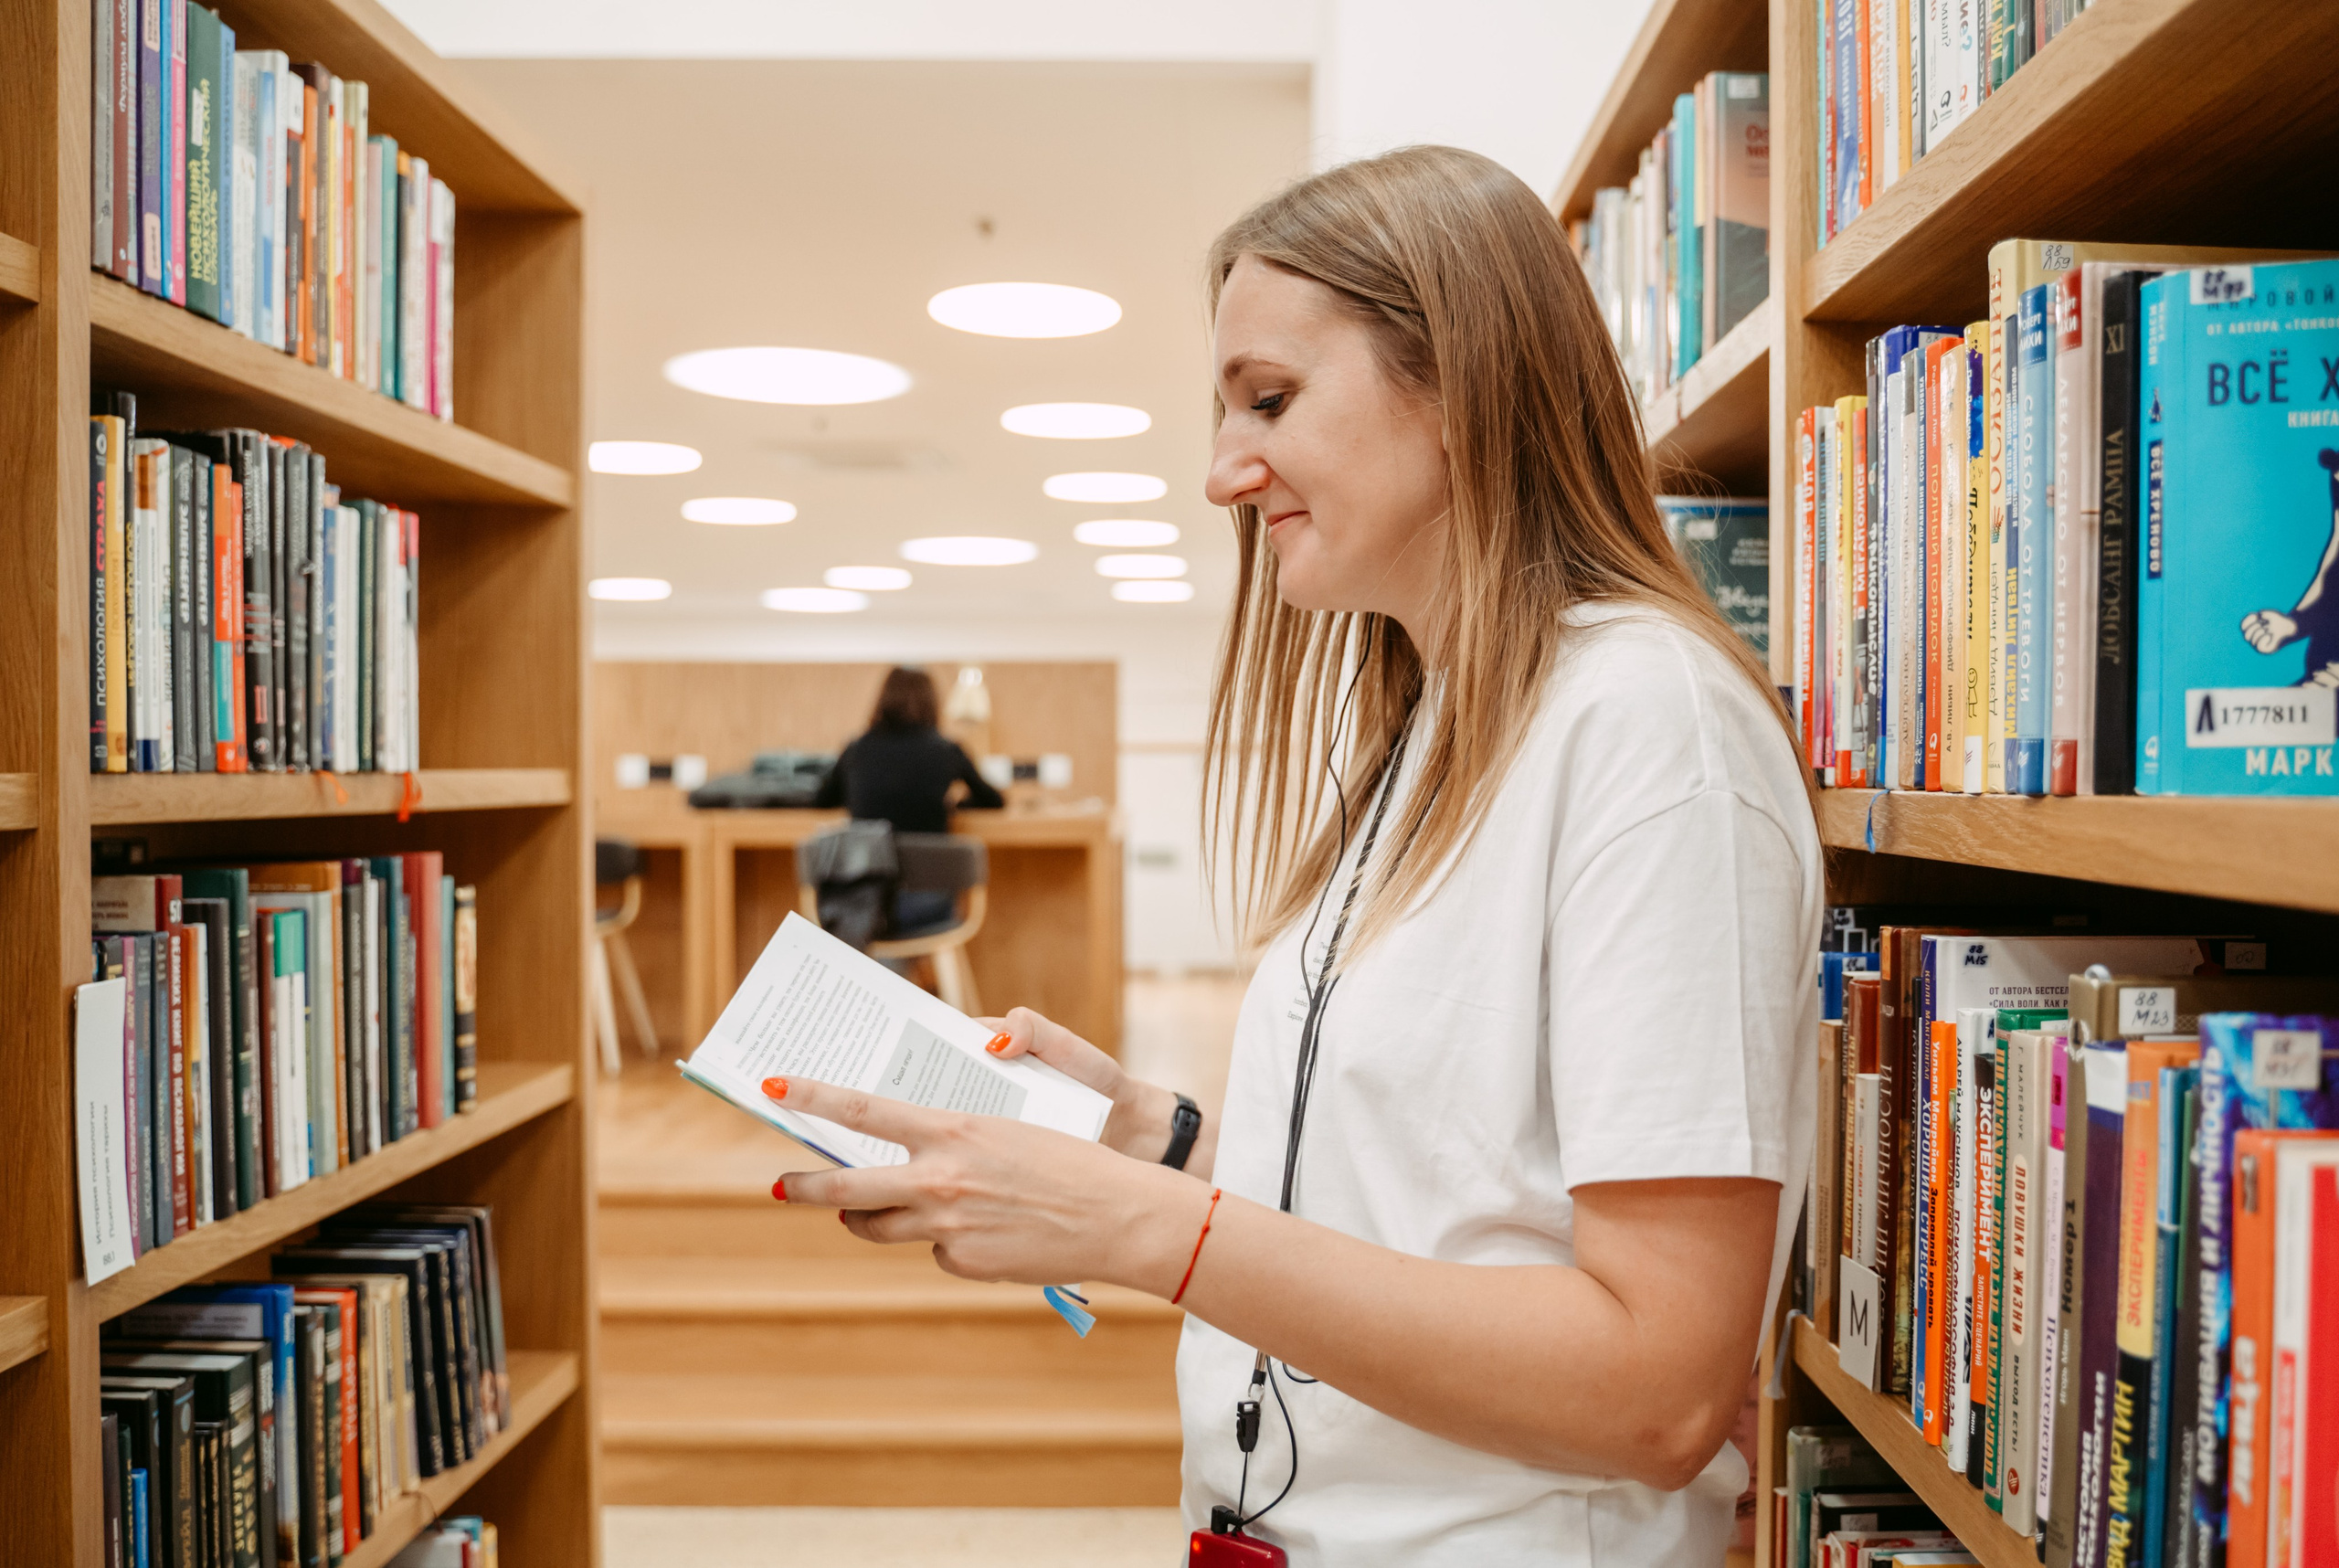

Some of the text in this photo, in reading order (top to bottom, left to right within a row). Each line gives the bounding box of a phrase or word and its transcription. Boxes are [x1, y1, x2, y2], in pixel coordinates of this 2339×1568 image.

[118, 42, 129, 113] Формула
[1991, 16, 2002, 60] КАК
[188, 158, 203, 279] НОВЕЙШИЙ
[199, 78, 211, 283] ПСИХОЛОГИЧЕСКИЙ
[209, 187, 218, 285] СЛОВАРЬ
[224, 185, 232, 291] ПСИХОЛОГИЯ
[2046, 245, 2063, 258] 88
[1990, 268, 2002, 495] ОСЯЗАНИЕ
[2105, 323, 2126, 355] XI
[2207, 322, 2278, 336] ОТ АВТОРА
[2207, 349, 2290, 406] ВСЁ
[179, 503, 190, 624] ЭЛЛЕНБЕРГЕР
[1857, 462, 1866, 592] МЕГАПОЛИСЕ
[1931, 463, 1939, 556] ПОЛНЫЙ
[2020, 394, 2034, 702] СВОБОДА ОТ ТРЕВОГИ
[2055, 376, 2068, 708] ЛЕКАРСТВО ОТ НЕРВОВ
[2100, 429, 2124, 665] ЛОБСАНГ РАМПА
[2148, 484, 2163, 574] ХРЕНОВО
[95, 481, 106, 705] ПСИХОЛОГИЯ СТРАХА
[163, 564, 171, 615] СРЕДА
[197, 509, 208, 628] ЭЛЛЕНБЕРГЕР
[1868, 523, 1877, 695] ФРИКОМЫСЛИЕ
[1989, 561, 2000, 716] Дэвид Линден
[2004, 567, 2018, 739] Михаил Литван
[2220, 705, 2310, 725] 1777811
[2246, 748, 2334, 777] МАРК
[169, 898, 182, 925] 50
[1968, 944, 1984, 954] 88
[748, 1039, 760, 1054] Чем
[757, 1018, 773, 1040] больше
[774, 1036, 787, 1052] ваша
[788, 1021, 808, 1048] показатели
[1989, 986, 2000, 996] ОТ
[2002, 986, 2032, 996] АВТОРА
[2134, 992, 2157, 1006] 88
[171, 936, 185, 1177] ВЕЛИКИХ КНИГ ПО ПСИХОЛОГИИ
[785, 1054, 800, 1075] Учась,
[809, 1042, 820, 1055] Этот
[844, 1054, 861, 1075] сможете
[89, 1101, 102, 1245] История психологии
[102, 1104, 115, 1239] Психология тарихы
[1846, 1034, 1857, 1237] ПСИХОЛОГИЧЕСКИЕ ТЕСТЫ
[1877, 1064, 1892, 1218] ЛИЧНОСТИ
[1928, 1040, 1941, 1329] Уильям Макрейвен Заправляй кровать
[1979, 1086, 1993, 1263] ЭКСПЕРИМЕНТ
[1920, 1211, 1931, 1290] СТРЕСС
[1943, 1159, 1953, 1327] ПОЖИЛОГО ВОЗРАСТА
[1984, 1047, 2005, 1475] ПОПУЛЯРНАЯ ИСТОРИЯ ПСИХОЛОГИИ
[2013, 1164, 2027, 1258] ЛОВУШКИ
[2126, 1151, 2147, 1328] ЭКСПЕРИМЕНТЫ
[2196, 1047, 2224, 1484] МОТИВАЦИЯ И ЛИЧНОСТЬ
[1850, 1290, 1869, 1347] М
[1949, 1209, 1961, 1397] ПСИХОФИЛОСОФИЯ
[1974, 1321, 1984, 1366] СЦЕНАРИЙ
[1975, 1274, 1984, 1319] ЗАПУСТИТЕ
[2012, 1266, 2024, 1335] ЖИЗНИ
[2059, 1200, 2077, 1406] Игорь Манн Номер 1
[2011, 1411, 2019, 1452] ЕСТЬ!
[2012, 1353, 2020, 1405] ВЫХОД
[2040, 1315, 2057, 1499] Психогенетика
[2232, 1335, 2260, 1507] лица
[2076, 1431, 2093, 1567] ИСТОРИЯ
[2085, 1372, 2108, 1568] ПСИХОЛОГИИ
[2107, 1381, 2136, 1512] МАРТИН
